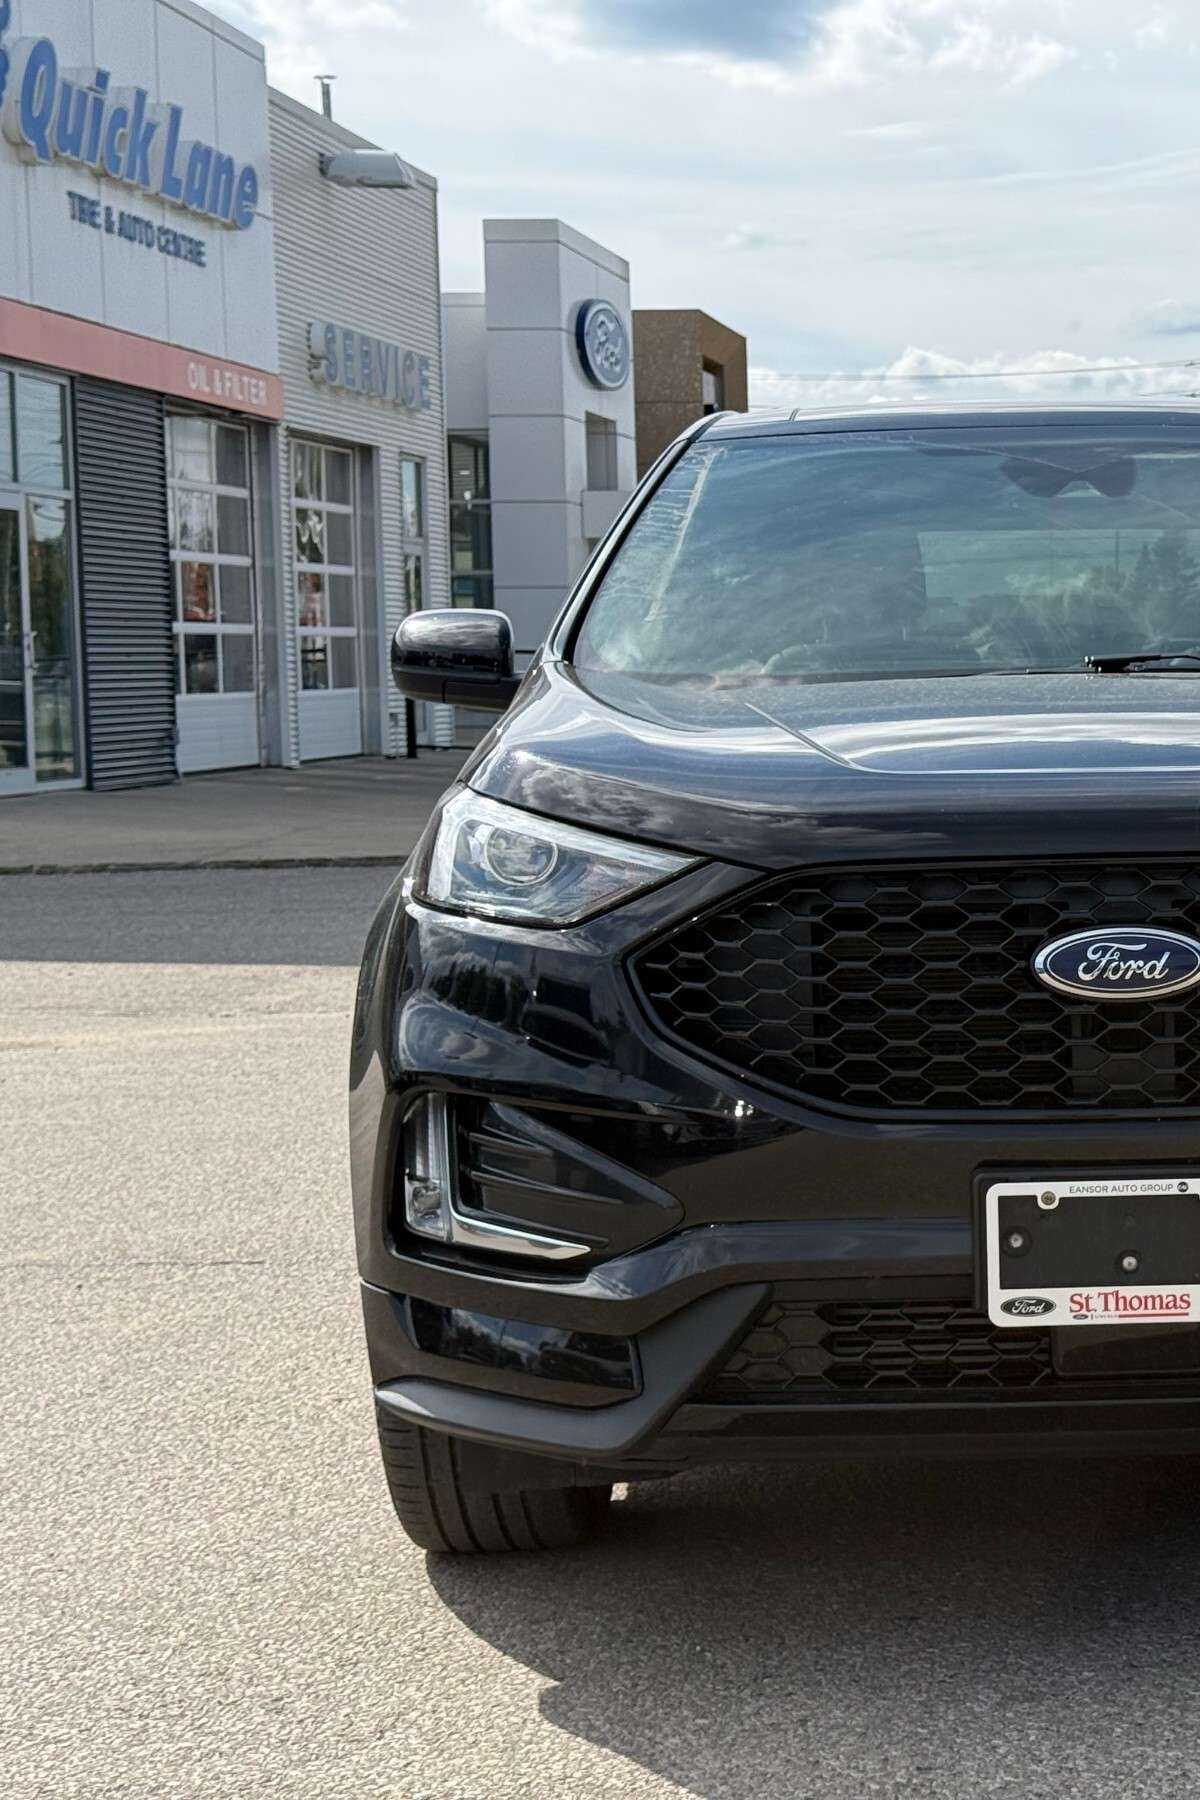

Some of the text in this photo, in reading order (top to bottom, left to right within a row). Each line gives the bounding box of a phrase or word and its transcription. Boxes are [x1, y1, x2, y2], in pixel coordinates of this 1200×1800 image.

[20, 39, 258, 231] Quick Lane
[66, 190, 101, 229] TIRE
[118, 210, 155, 249] AUTO
[186, 361, 267, 407] OIL & FILTER
[322, 322, 433, 410] SERVICE
[1077, 942, 1171, 982] Ford
[1069, 1185, 1108, 1194] EANSOR
[1110, 1184, 1138, 1193] AUTO
[1140, 1183, 1174, 1192] GROUP
[1011, 1299, 1045, 1314] Ford
[1097, 1289, 1192, 1312] Thomas
